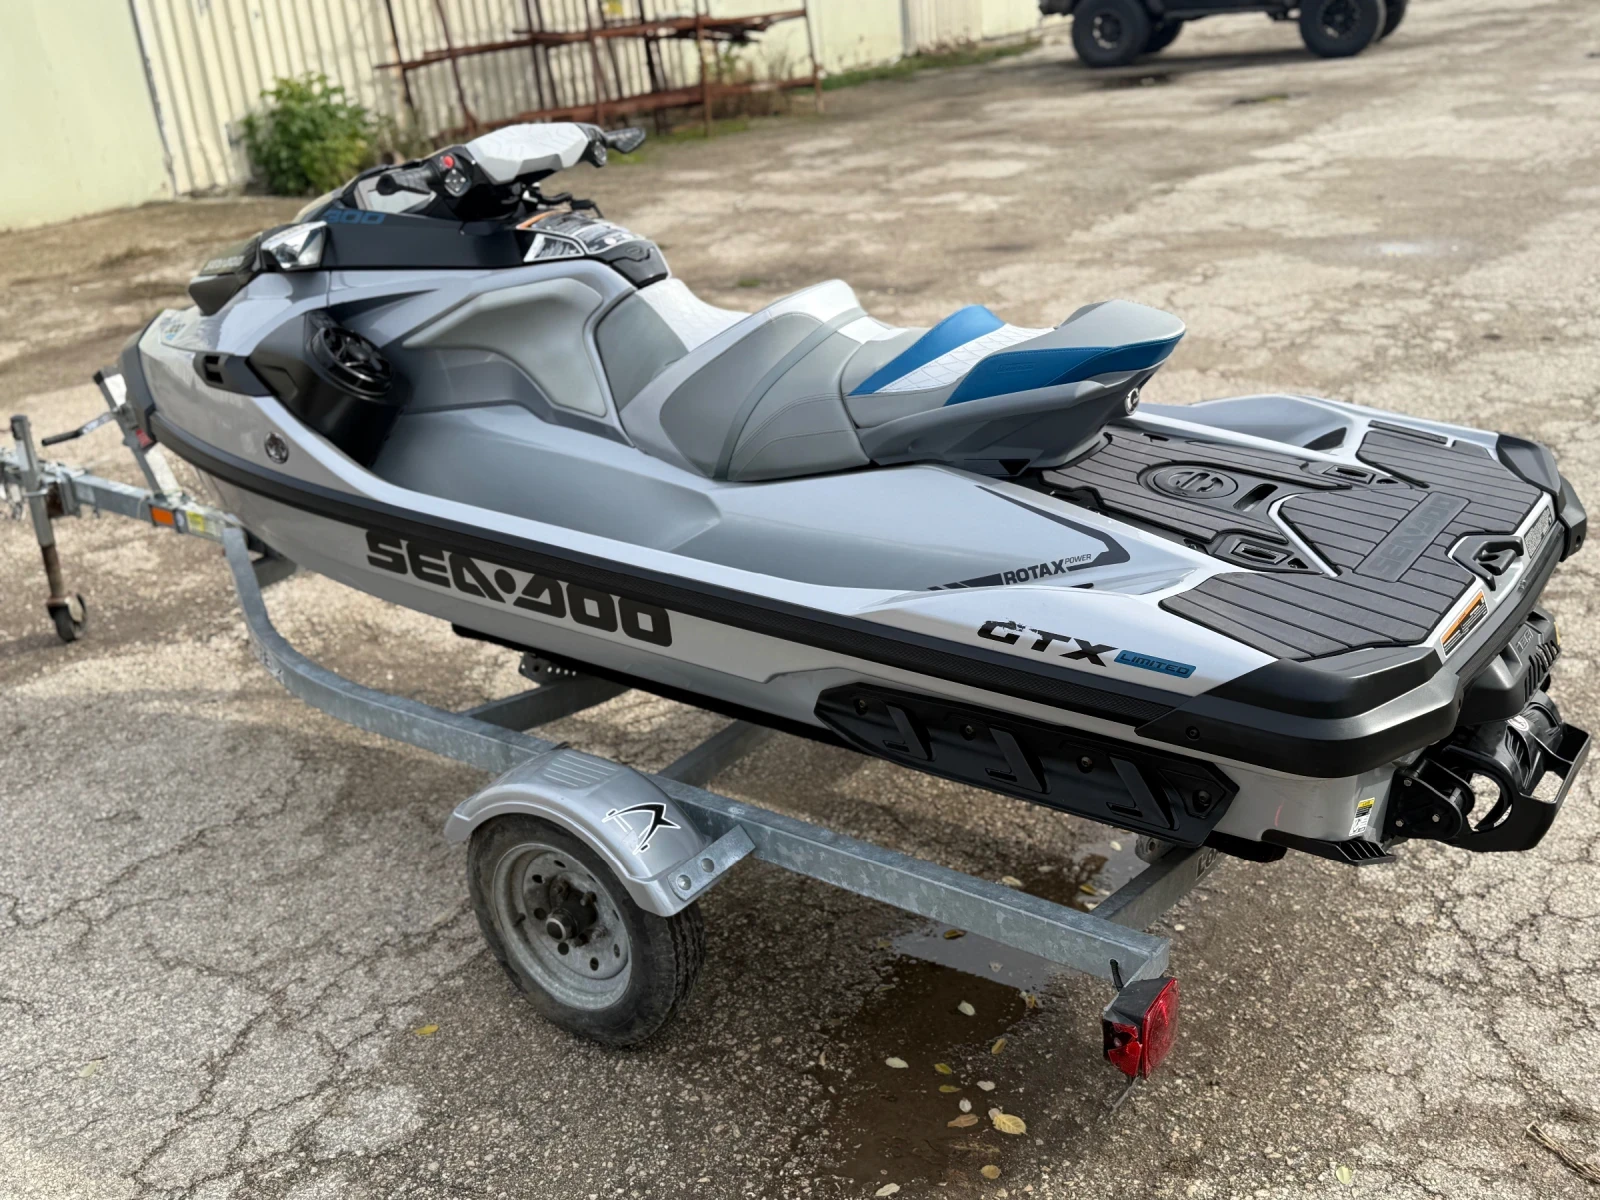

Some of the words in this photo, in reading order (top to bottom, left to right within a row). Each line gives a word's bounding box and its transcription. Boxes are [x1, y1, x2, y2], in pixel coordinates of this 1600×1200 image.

[323, 208, 387, 225] 300
[1003, 559, 1066, 586] ROTAX
[1064, 553, 1092, 566] POWER
[977, 620, 1119, 667] GTX
[1119, 652, 1191, 676] LIMITED
